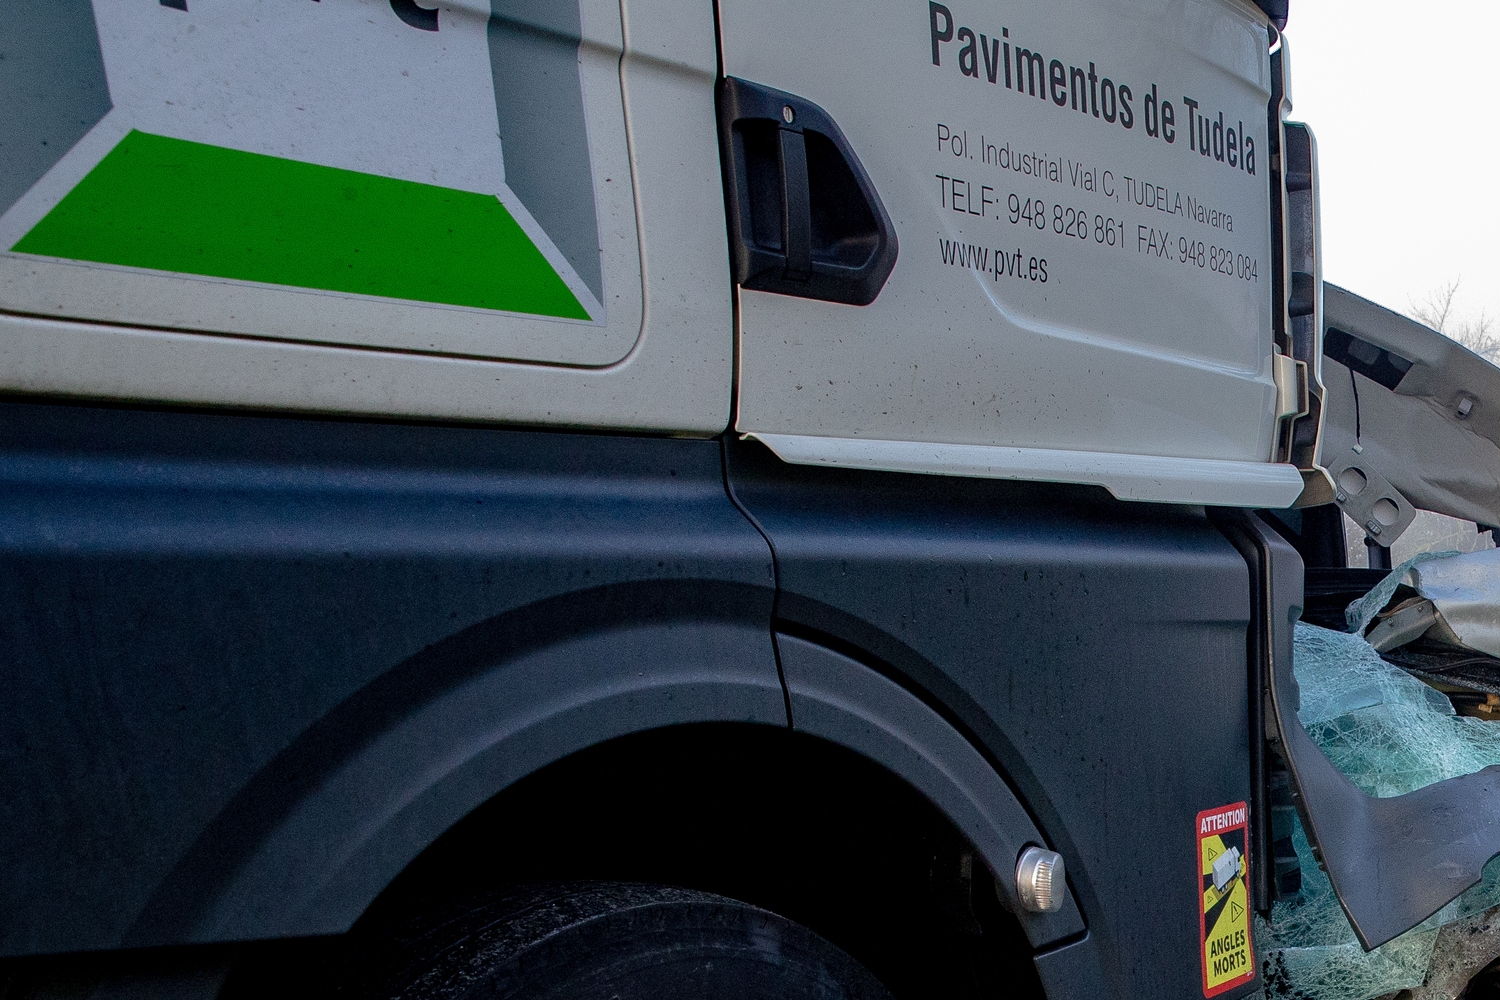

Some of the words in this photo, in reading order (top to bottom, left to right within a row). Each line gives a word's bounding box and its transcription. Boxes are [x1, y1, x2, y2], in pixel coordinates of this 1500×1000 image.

[929, 0, 1134, 129] Pavimentos
[1144, 83, 1175, 143] de
[1183, 96, 1256, 176] Tudela
[937, 123, 973, 160] Pol.
[981, 135, 1063, 183] Industrial
[1067, 159, 1098, 193] Vial
[1102, 170, 1119, 203] C,
[1123, 176, 1184, 217] TUDELA
[1187, 195, 1234, 232] Navarra
[935, 174, 999, 220] TELF:
[1008, 193, 1046, 230] 948
[1053, 204, 1088, 240] 826
[1094, 214, 1125, 248] 861
[1137, 225, 1173, 260] FAX:
[1178, 236, 1206, 268] 948
[1209, 245, 1234, 276] 823
[1237, 254, 1259, 283] 084
[939, 238, 1048, 283] www.pvt.es
[1200, 807, 1245, 834] ATTENTION
[1210, 929, 1246, 959] ANGLES
[1213, 949, 1247, 978] MORTS
